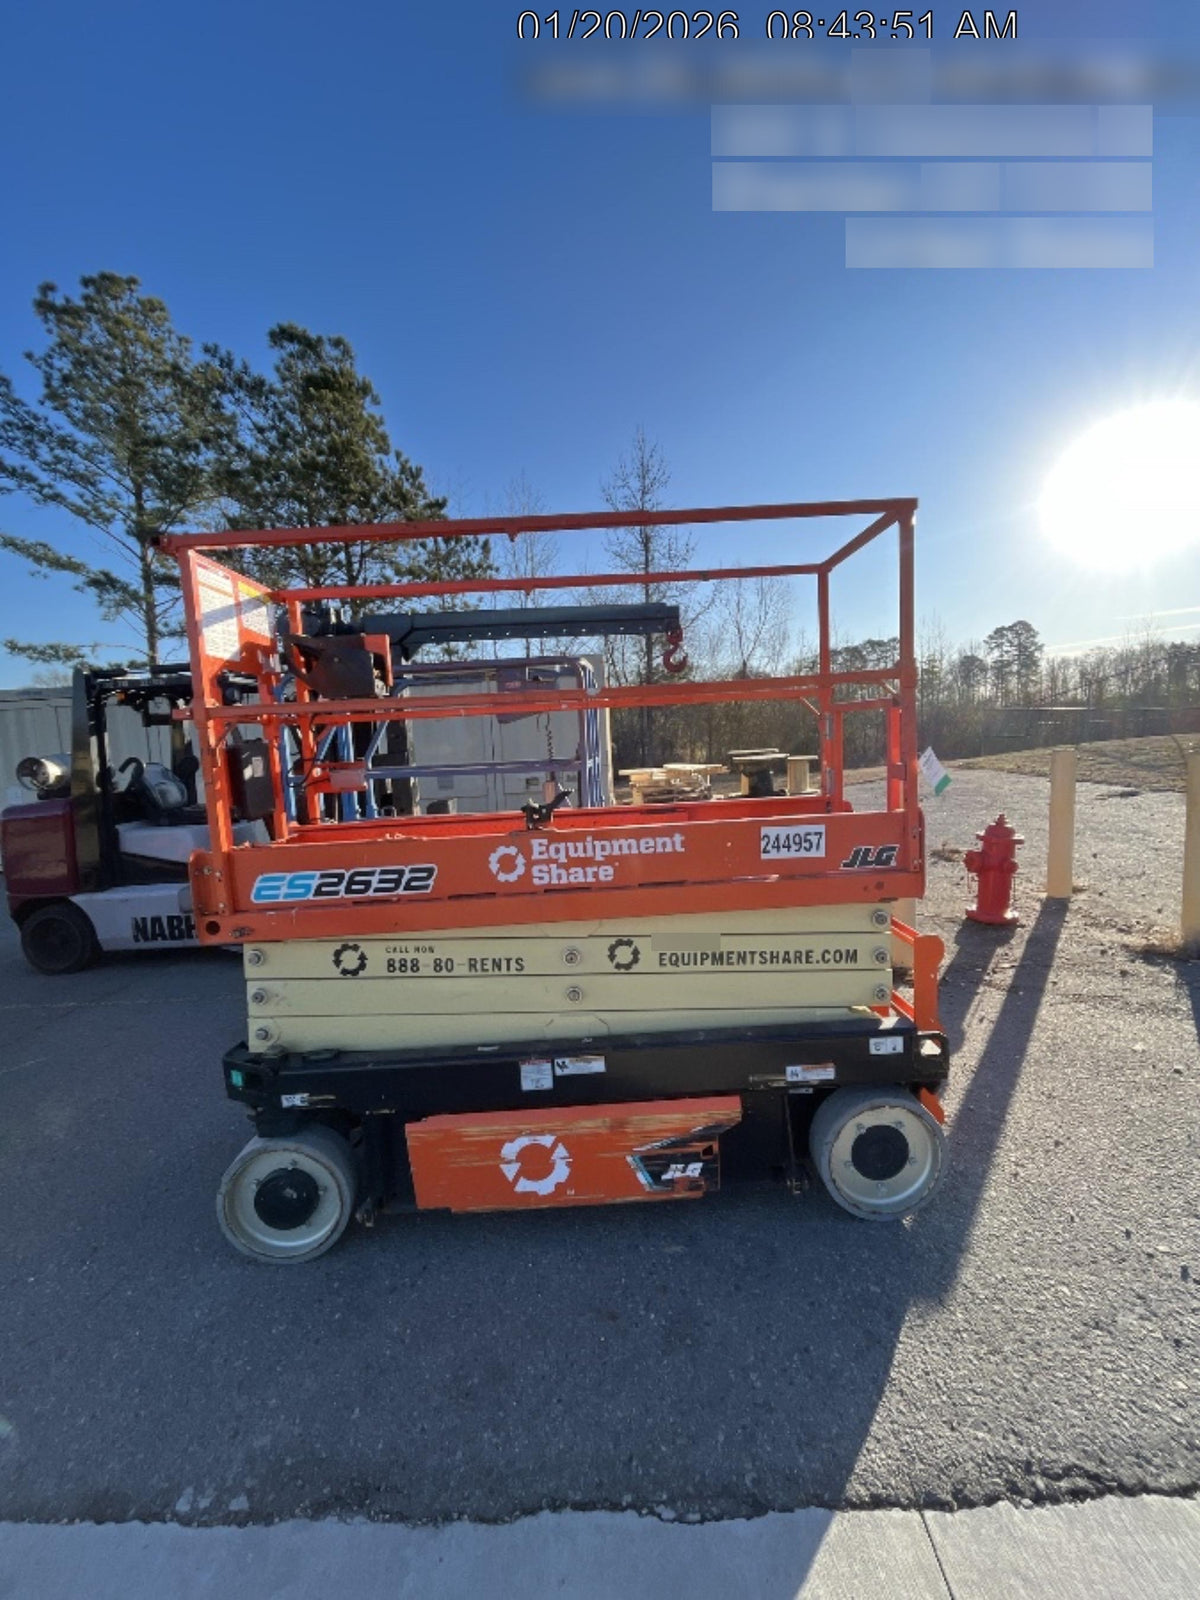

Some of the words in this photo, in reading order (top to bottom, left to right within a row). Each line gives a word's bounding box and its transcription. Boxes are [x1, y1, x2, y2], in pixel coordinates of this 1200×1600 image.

[531, 833, 685, 862] Equipment
[762, 832, 823, 854] 244957
[839, 843, 900, 869] JLG
[251, 864, 437, 903] ES2632
[532, 864, 615, 886] Share
[658, 949, 859, 968] EQUIPMENTSHARE.COM
